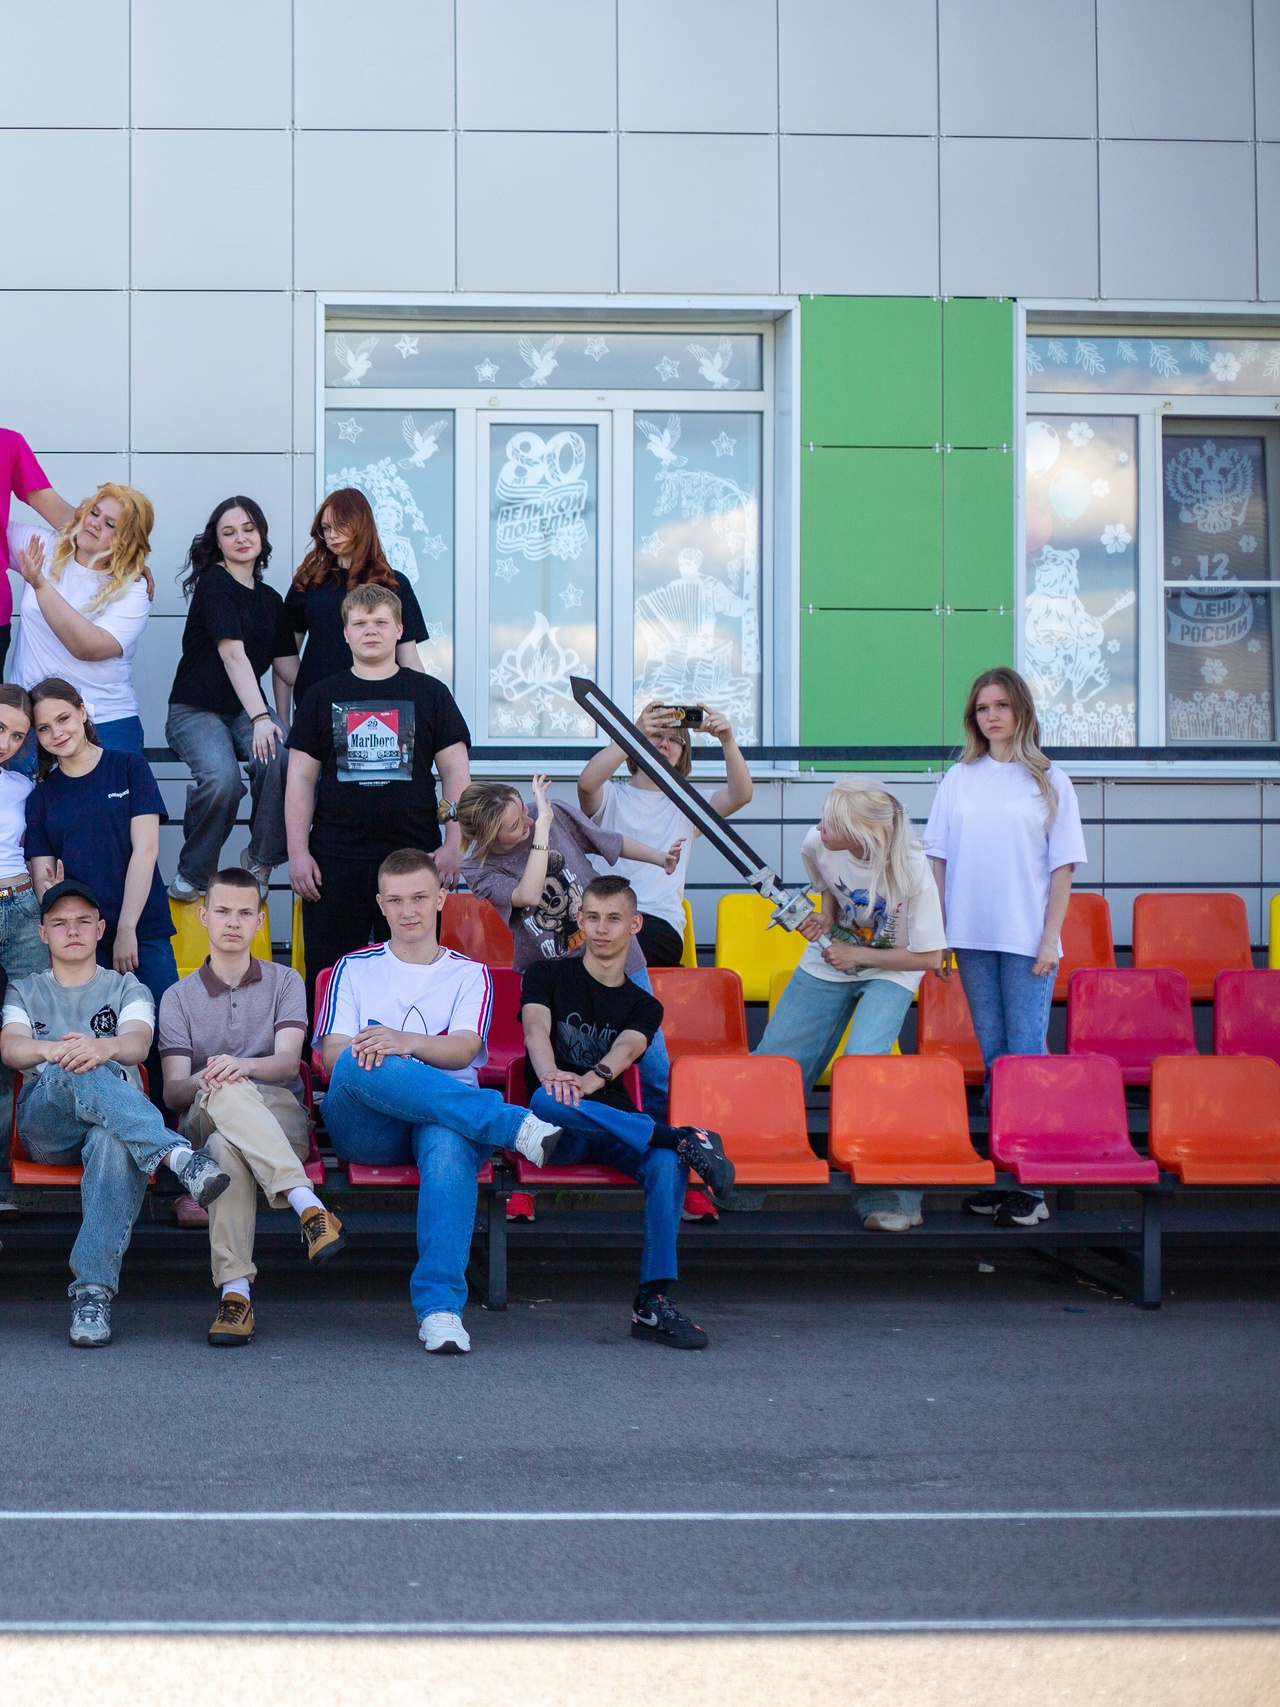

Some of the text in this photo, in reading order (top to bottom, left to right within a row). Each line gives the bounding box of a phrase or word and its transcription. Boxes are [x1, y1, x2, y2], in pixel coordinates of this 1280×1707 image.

[498, 431, 587, 488] 80
[499, 488, 585, 523] ВЕЛИКОЙ
[501, 510, 578, 540] ПОБЕДЫ
[1197, 553, 1230, 578] 12
[1193, 600, 1236, 617] ДЕНЬ
[1180, 616, 1248, 642] РОССИИ
[351, 733, 395, 748] Marlboro
[566, 1012, 618, 1041] Calvin
